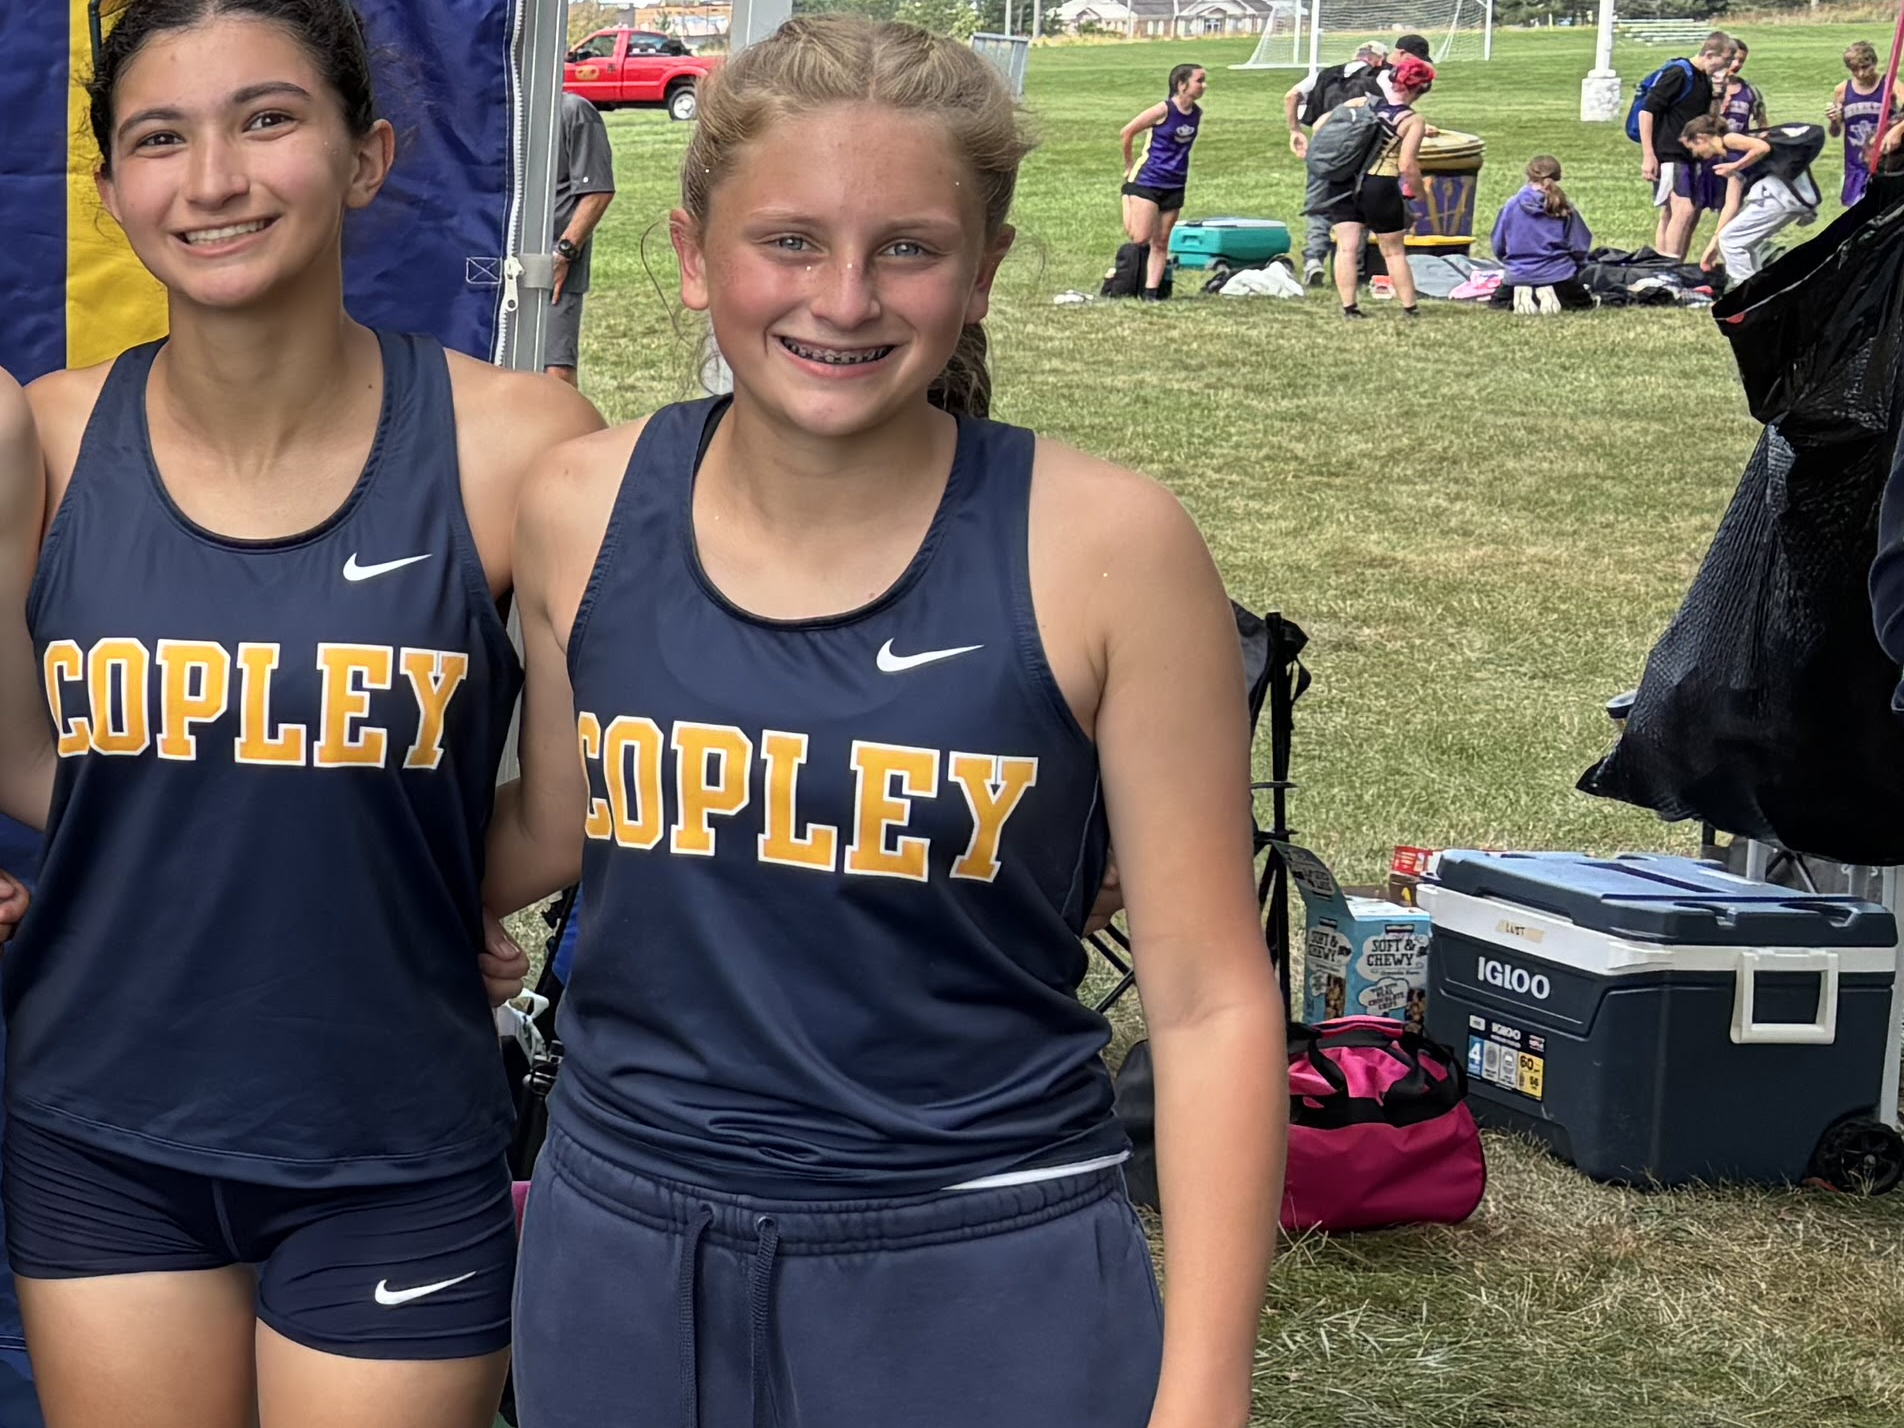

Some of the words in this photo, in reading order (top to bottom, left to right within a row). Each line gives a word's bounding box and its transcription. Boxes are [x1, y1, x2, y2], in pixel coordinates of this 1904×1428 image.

[43, 638, 469, 770] COPLEY
[577, 711, 1039, 882] COPLEY
[1367, 953, 1414, 967] CHEWY
[1371, 939, 1402, 952] SOFT
[1404, 939, 1417, 952] &
[1477, 956, 1551, 1000] IGLOO
[1519, 1055, 1534, 1071] 60
